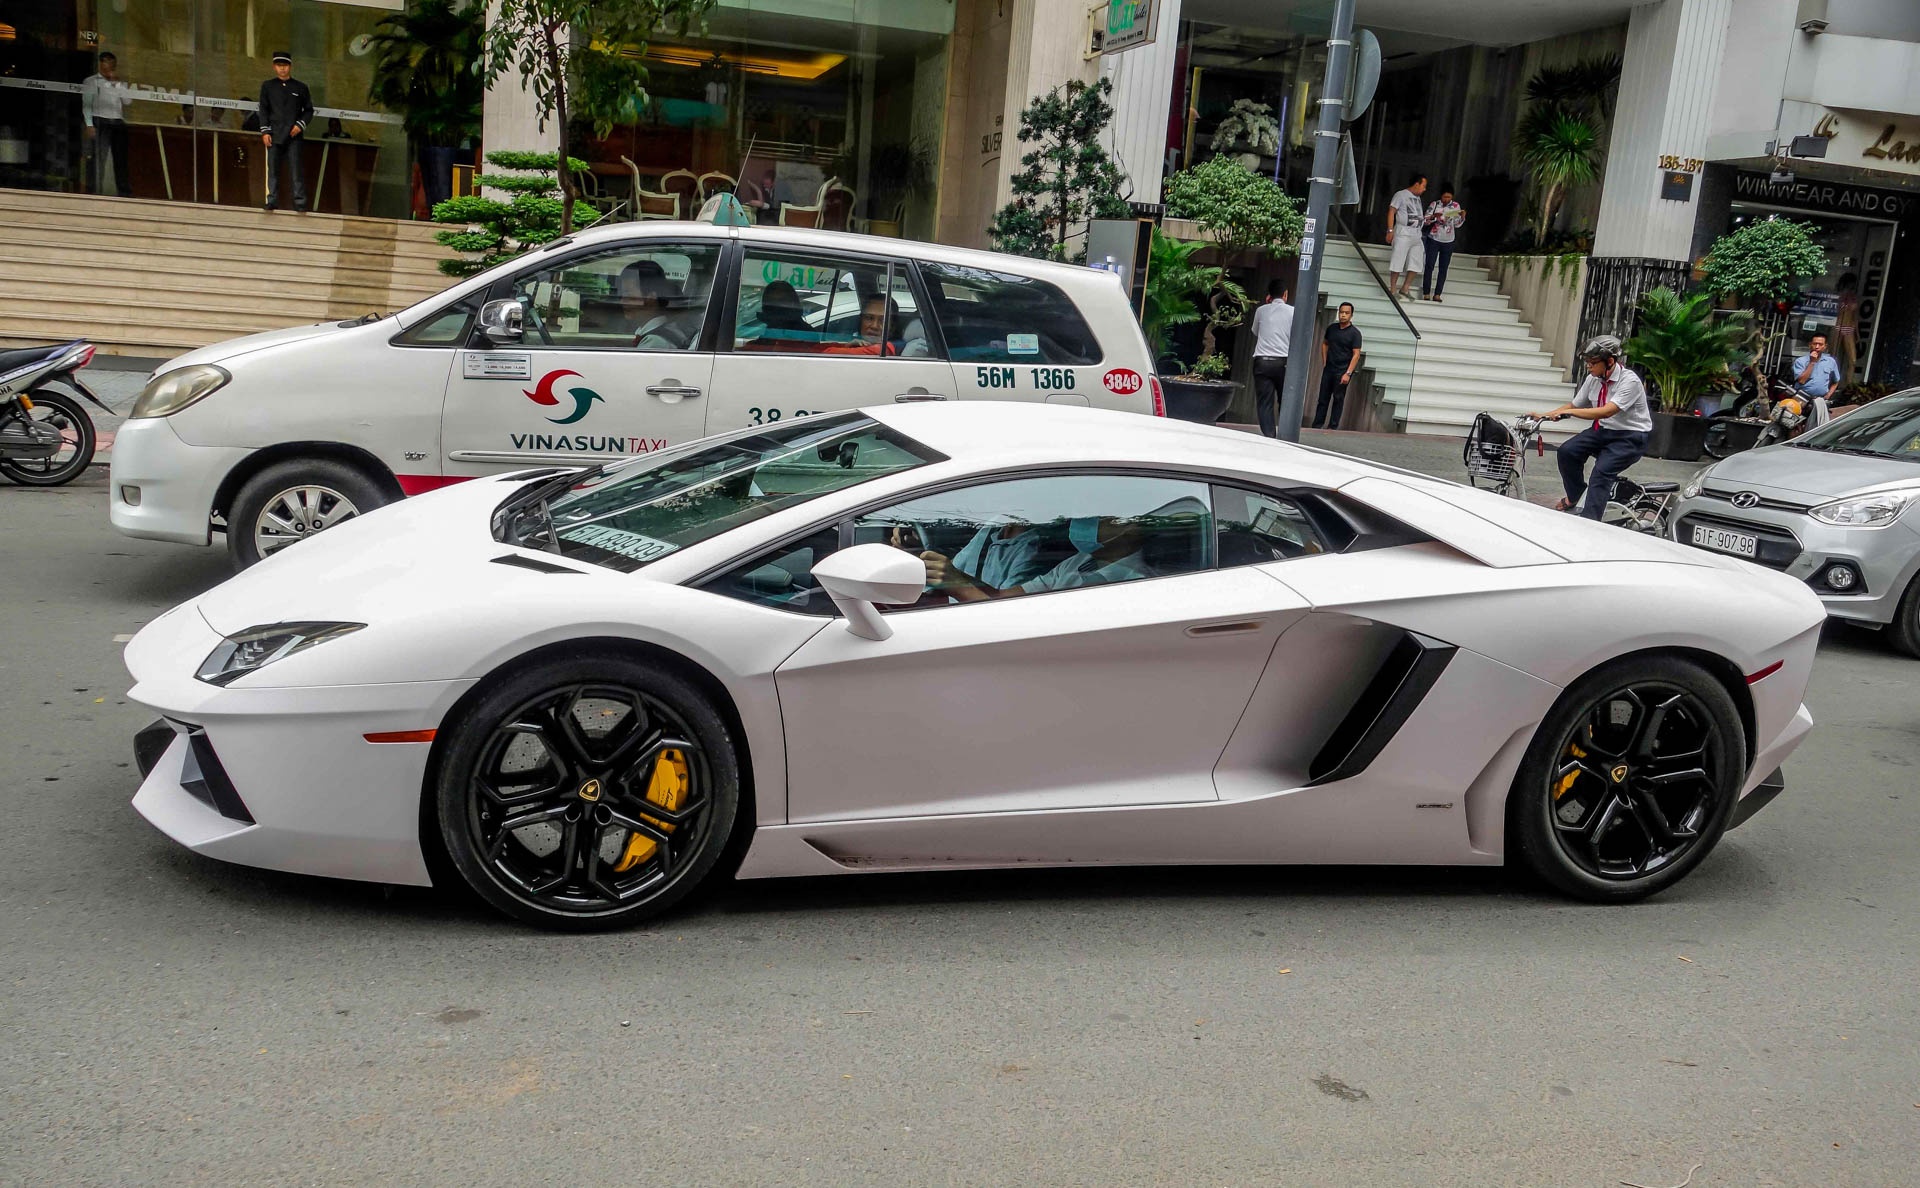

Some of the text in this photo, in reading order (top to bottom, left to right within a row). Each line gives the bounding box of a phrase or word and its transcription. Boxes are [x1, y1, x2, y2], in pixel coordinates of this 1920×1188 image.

[1658, 155, 1704, 173] 135-137
[1838, 192, 1879, 211] AND
[977, 366, 1076, 390] 56M 1366
[1105, 373, 1140, 390] 3849
[510, 433, 668, 453] VINASUN TAXI
